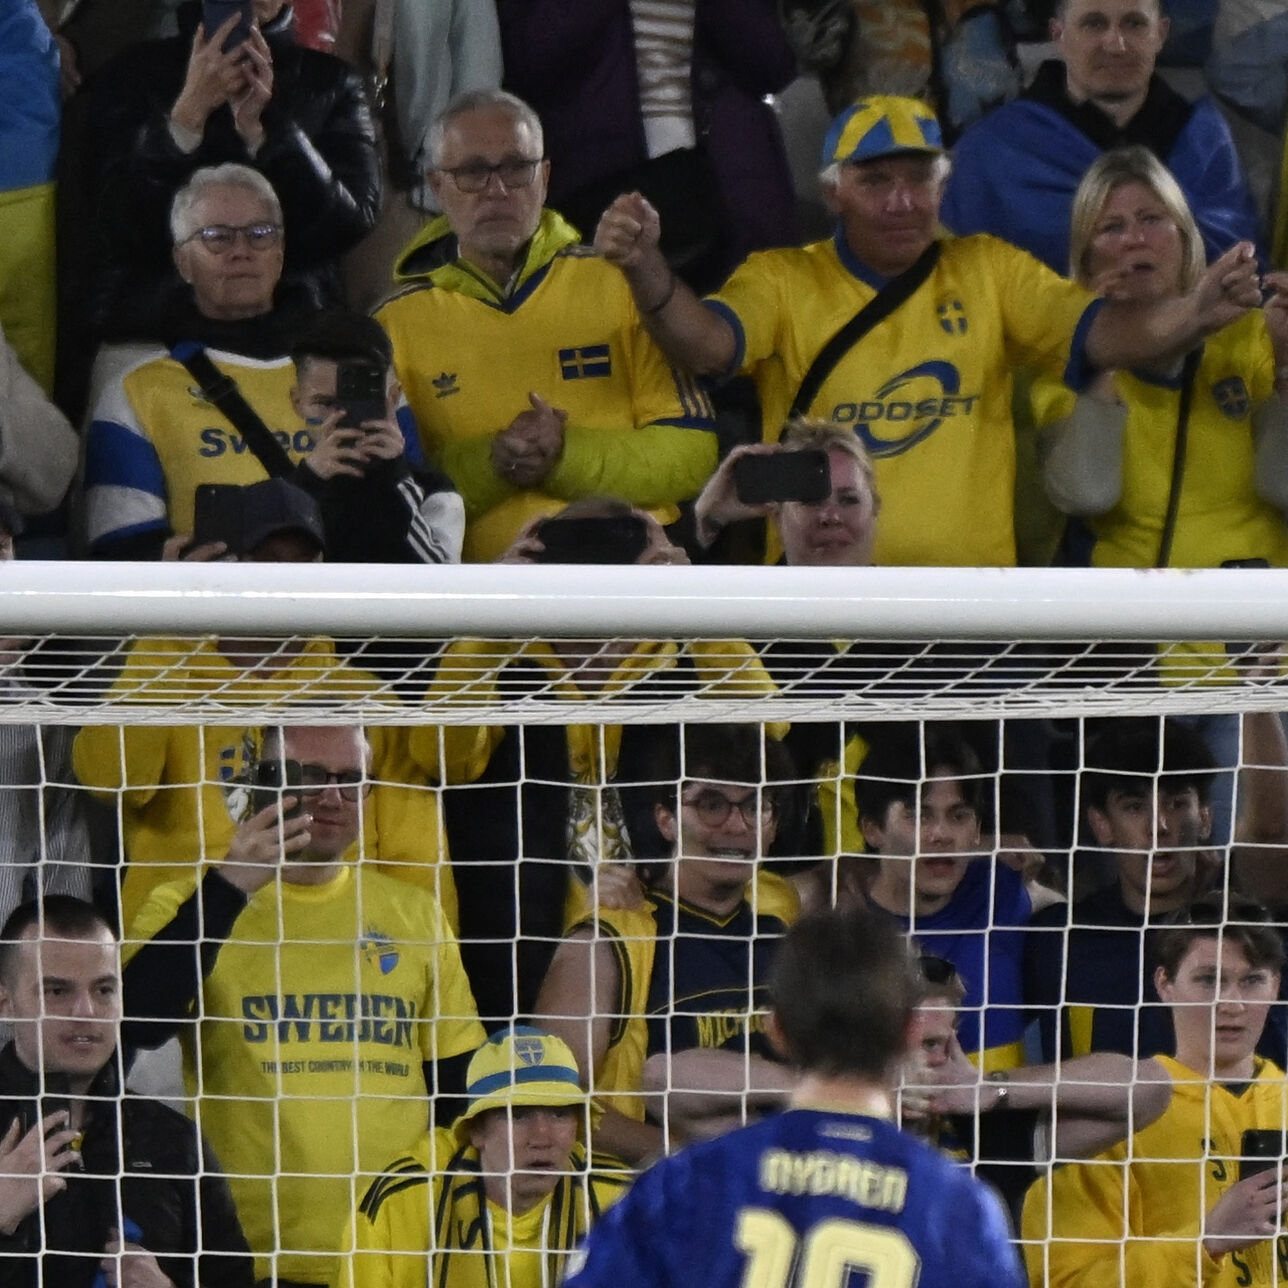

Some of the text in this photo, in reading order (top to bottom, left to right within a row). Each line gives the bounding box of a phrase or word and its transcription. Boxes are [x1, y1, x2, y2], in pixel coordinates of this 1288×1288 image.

[832, 396, 978, 423] ODDSET
[241, 994, 416, 1050] SWEDEN
[282, 1060, 305, 1074] BEST
[366, 1061, 385, 1074] THE
